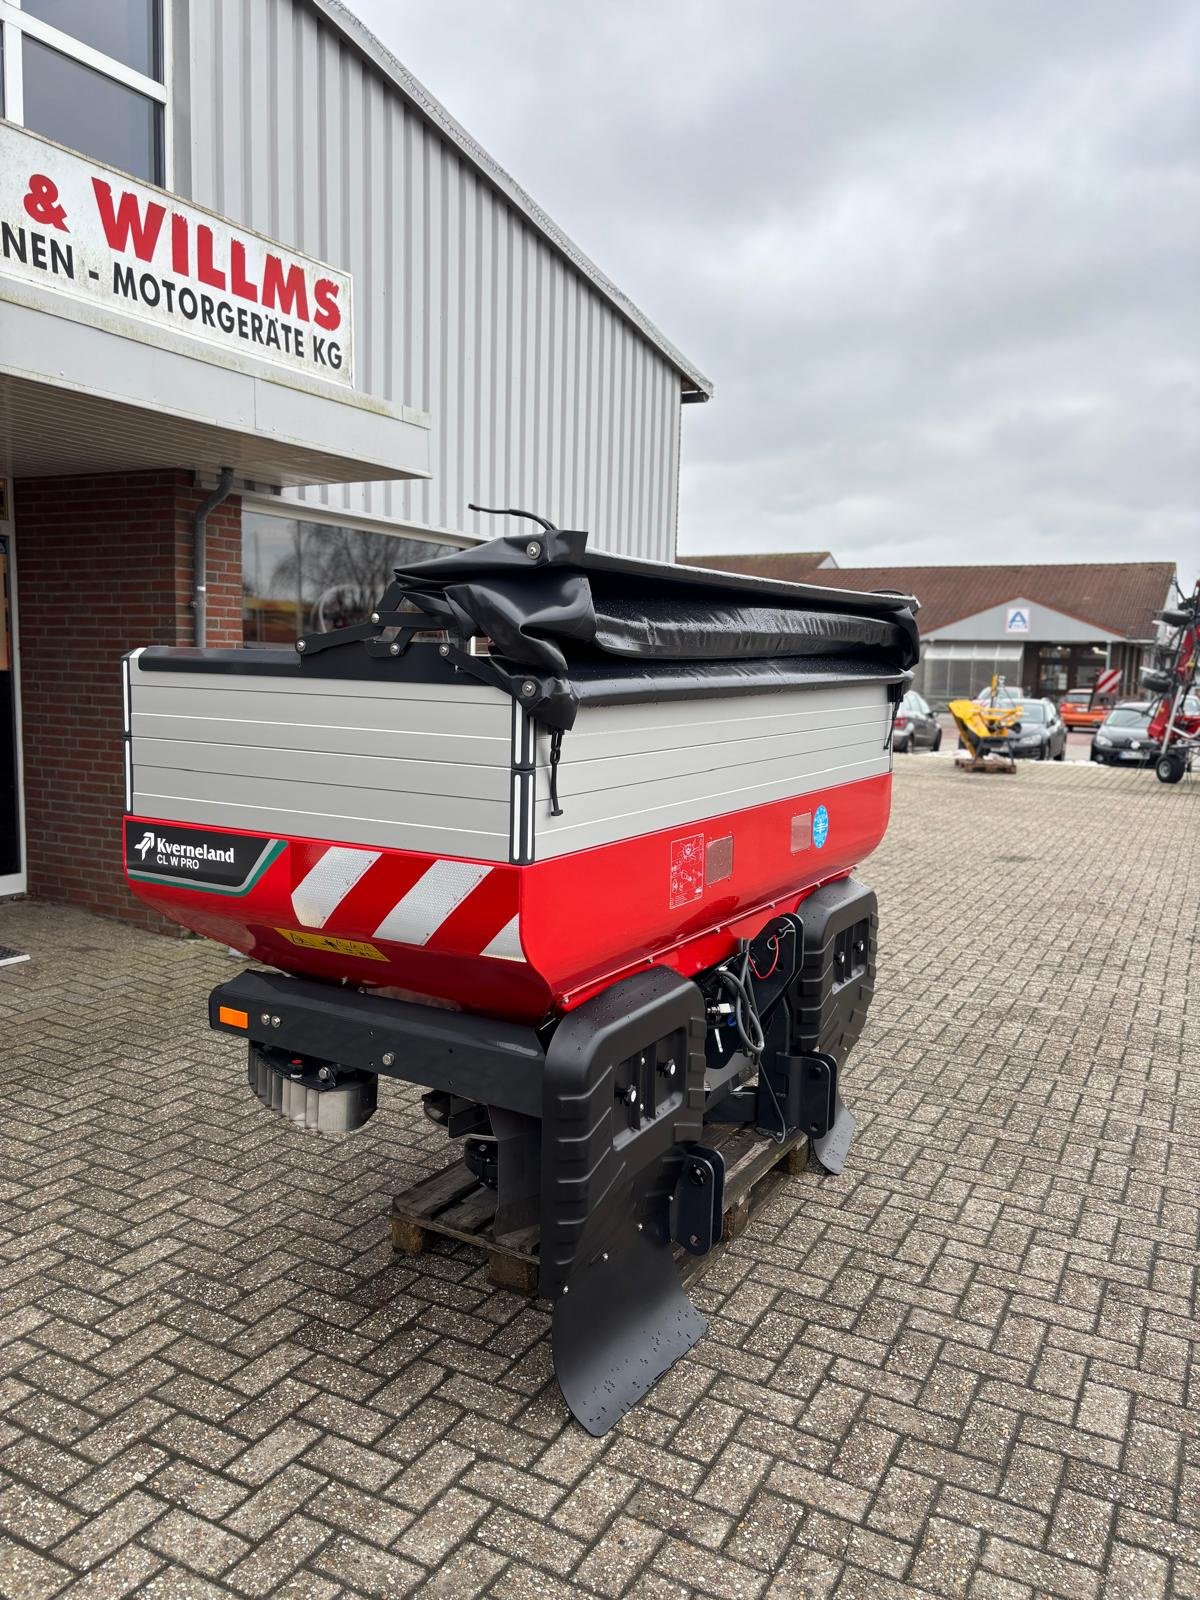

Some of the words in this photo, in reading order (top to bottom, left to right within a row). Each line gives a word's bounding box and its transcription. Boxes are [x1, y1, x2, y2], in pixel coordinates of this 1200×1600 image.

[1, 221, 75, 280] NEN
[113, 262, 304, 358] MOTORGERÄTE
[313, 335, 343, 369] KG
[23, 173, 70, 233] &
[91, 176, 341, 331] WILLMS
[156, 837, 235, 864] Kverneland
[156, 854, 169, 865] CL
[170, 855, 179, 867] W
[180, 857, 200, 870] PRO
